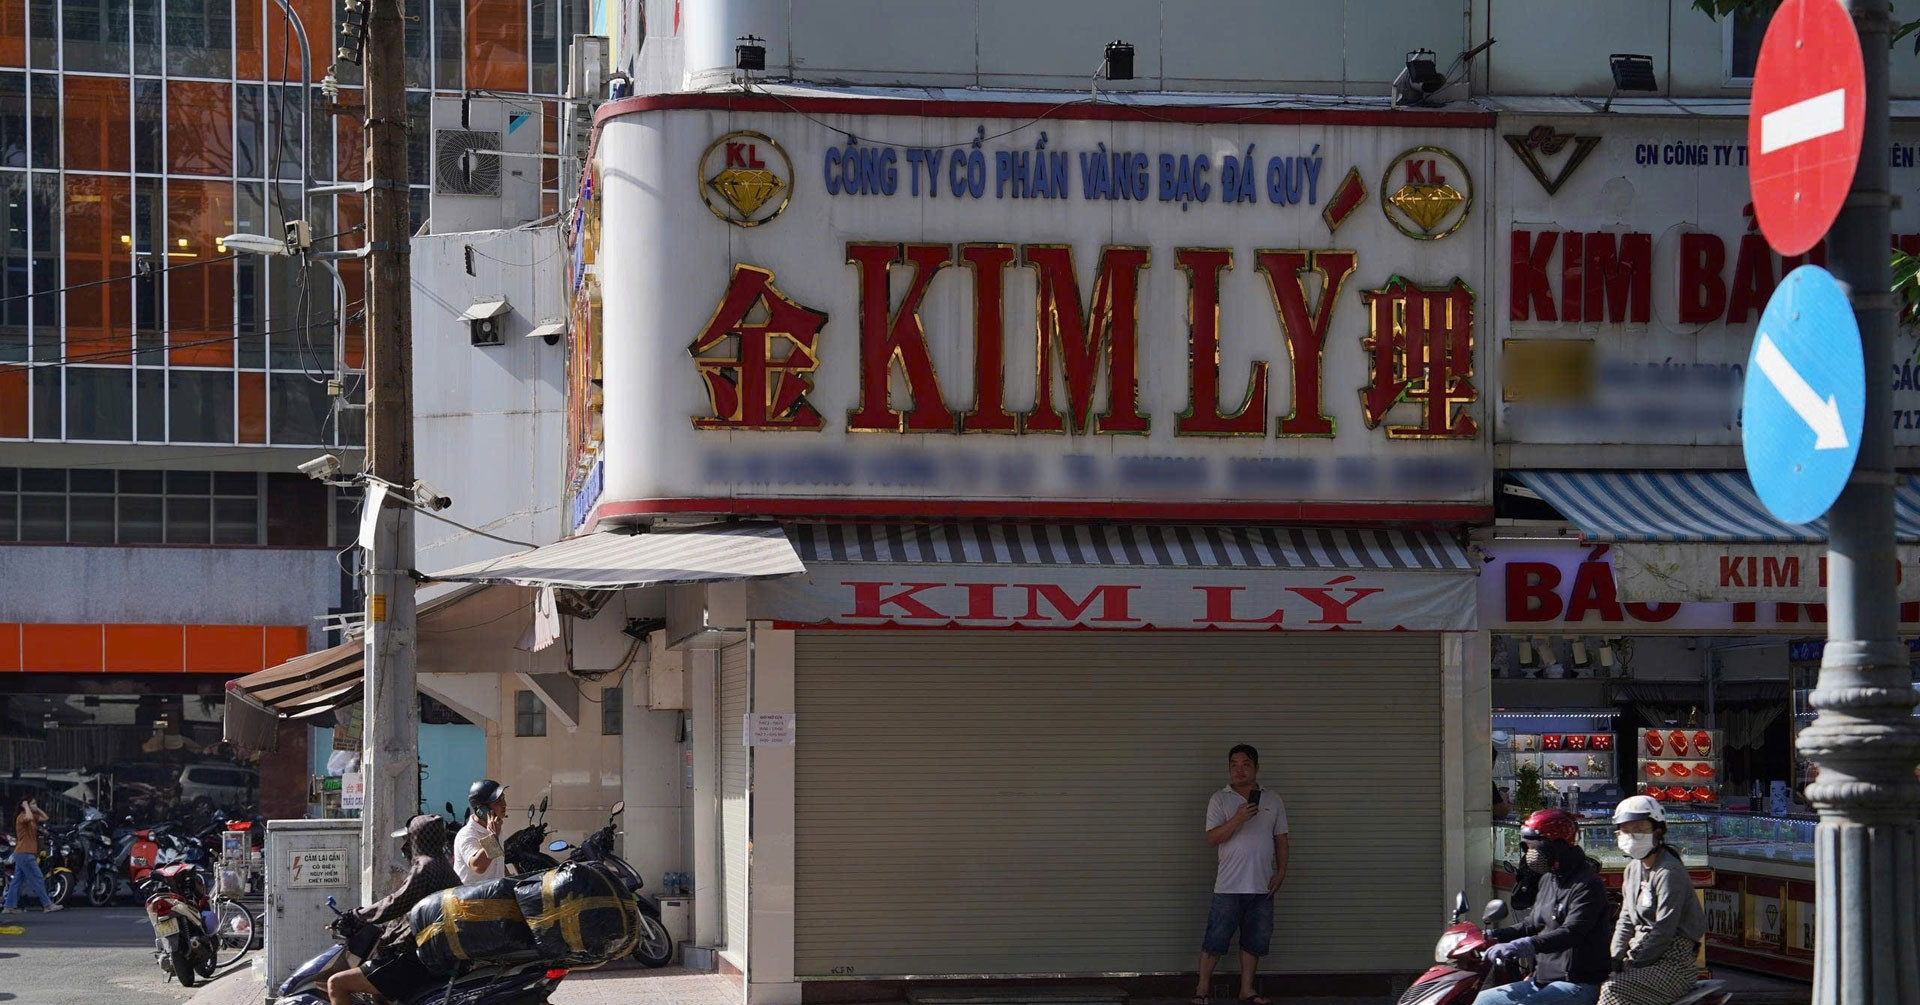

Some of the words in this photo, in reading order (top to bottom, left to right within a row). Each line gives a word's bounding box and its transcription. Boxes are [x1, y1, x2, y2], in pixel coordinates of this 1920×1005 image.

[726, 143, 766, 169] KL
[824, 133, 897, 196] CÔNG
[906, 150, 942, 198] TY
[949, 125, 986, 198] CỔ
[997, 131, 1069, 200] PHẦN
[1080, 142, 1150, 201] VÀNG
[1158, 153, 1211, 211] BẠC
[1221, 143, 1257, 203] ĐÁ
[1267, 144, 1322, 205] QUÝ
[1405, 159, 1445, 183] KL
[1635, 144, 1658, 165] CN
[1663, 140, 1708, 165] CÔNG
[1713, 145, 1732, 166] TY
[1737, 145, 1750, 166] T
[845, 241, 1151, 436] KIM
[1174, 165, 1369, 439] LÝ
[1510, 230, 1652, 323] KIM
[687, 262, 829, 433] 金
[1358, 274, 1479, 441] 理
[841, 581, 1142, 622] KIM
[1192, 575, 1385, 624] LÝ
[1719, 556, 1799, 588] KIM
